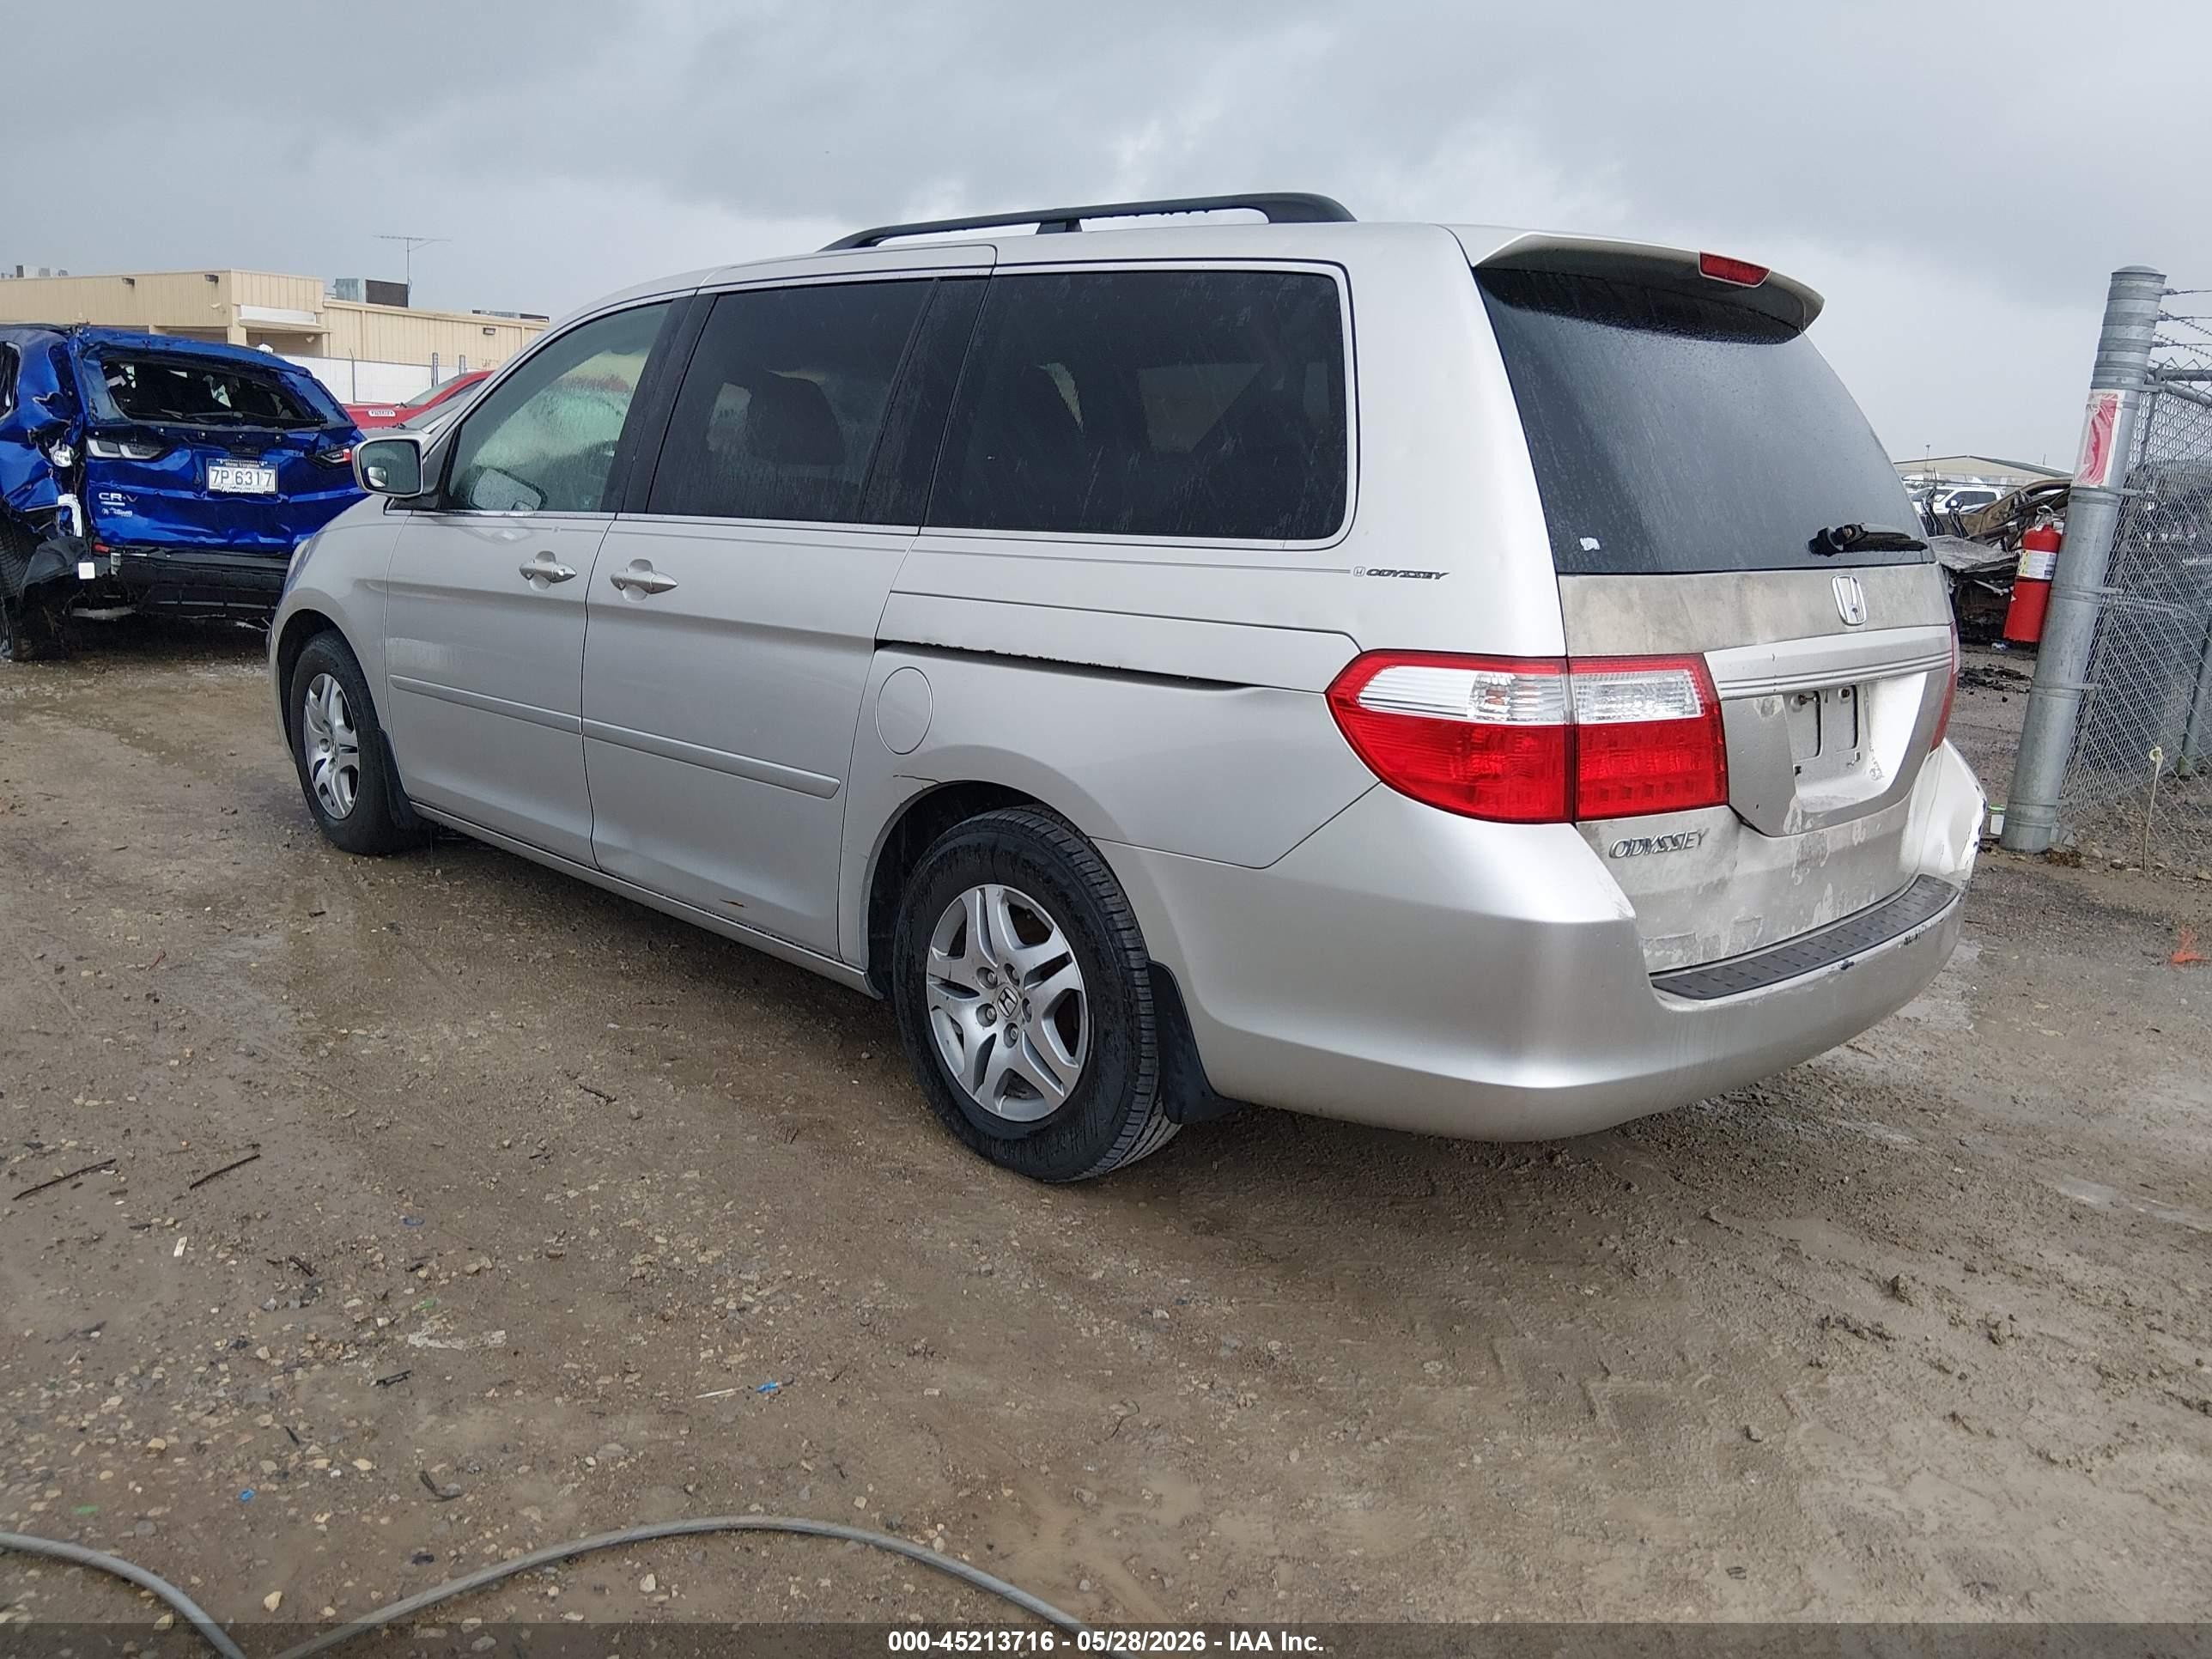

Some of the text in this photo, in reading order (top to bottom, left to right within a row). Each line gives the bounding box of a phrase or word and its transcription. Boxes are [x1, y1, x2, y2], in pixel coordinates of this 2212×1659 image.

[211, 469, 272, 487] 7P 6317
[1366, 568, 1449, 580] ODYSSEY
[1609, 828, 1711, 859] ODYSSEY
